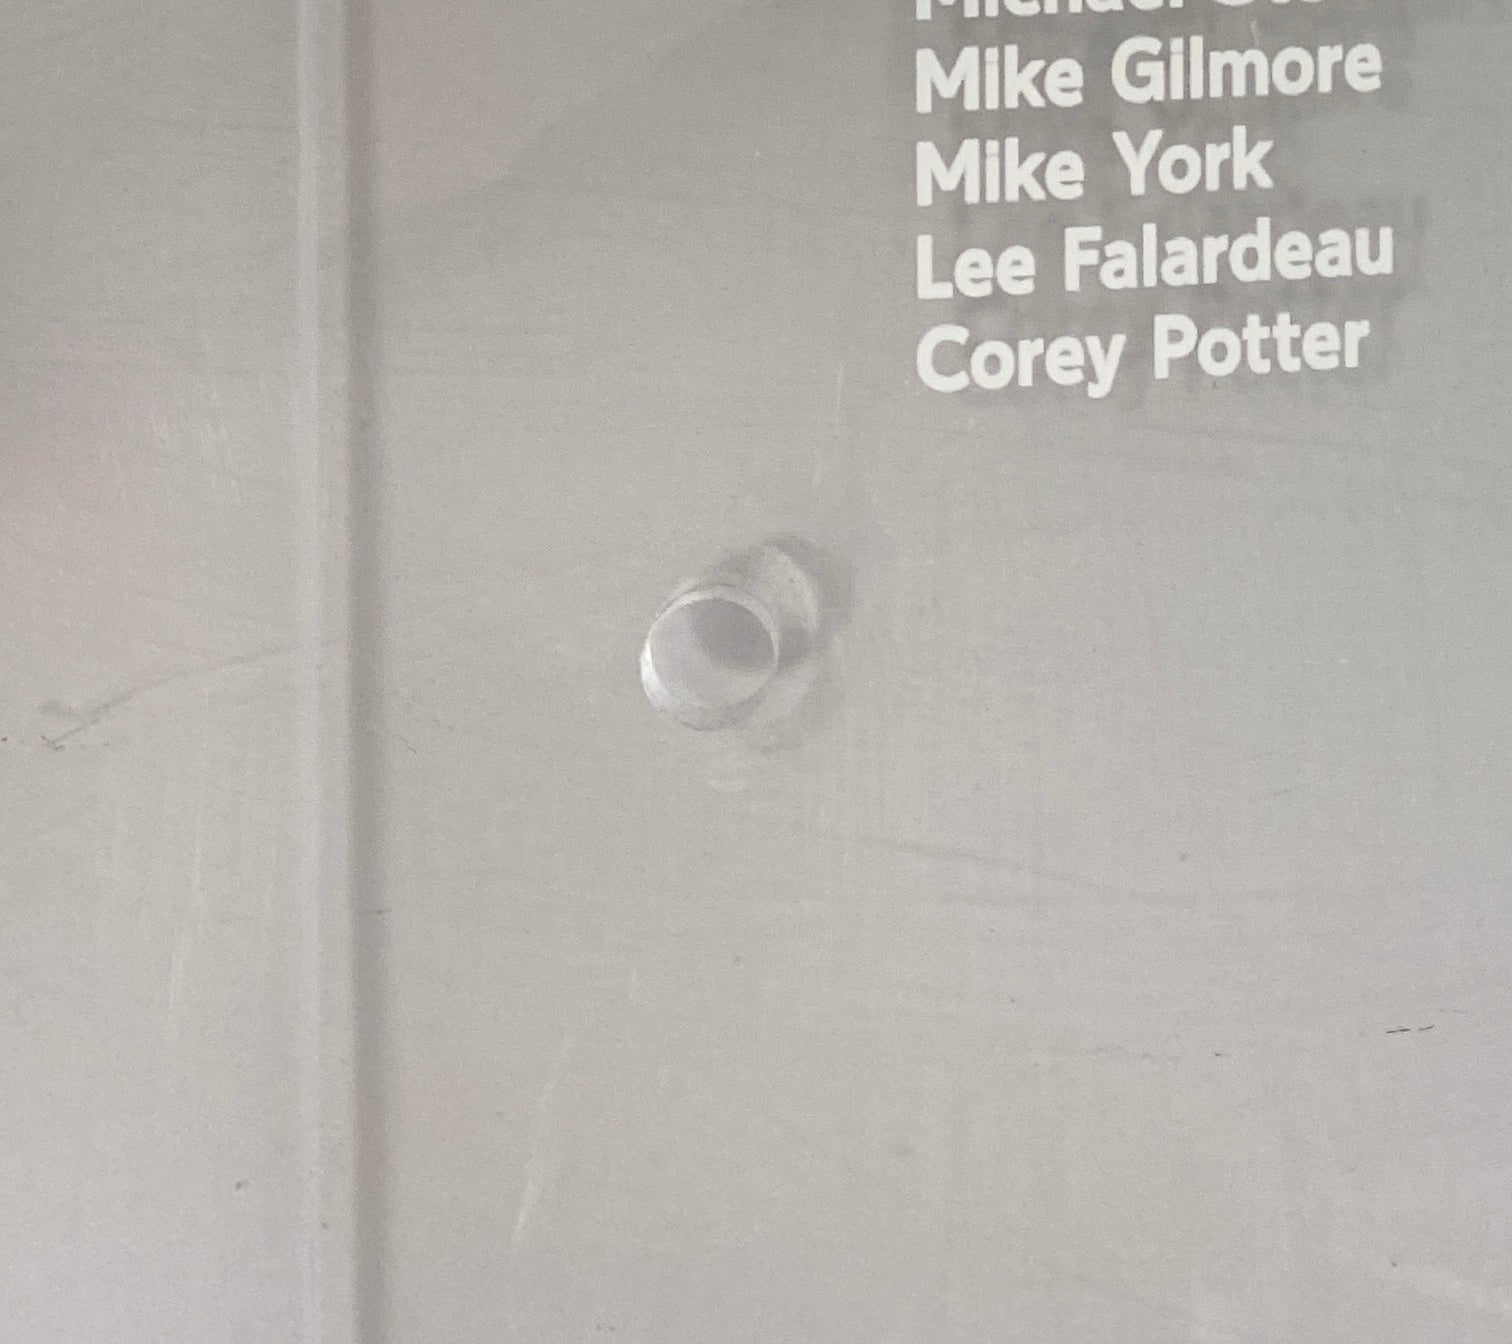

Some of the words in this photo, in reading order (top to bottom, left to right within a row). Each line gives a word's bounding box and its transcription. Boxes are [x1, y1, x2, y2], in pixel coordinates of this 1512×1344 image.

[914, 44, 1086, 115] Mike
[1109, 35, 1384, 106] Gilmore
[914, 136, 1087, 208] Mike
[1110, 124, 1275, 197] York
[915, 234, 1038, 301] Lee
[1063, 216, 1395, 293] Falardeau
[915, 323, 1128, 400] Corey
[1152, 312, 1372, 381] Potter
